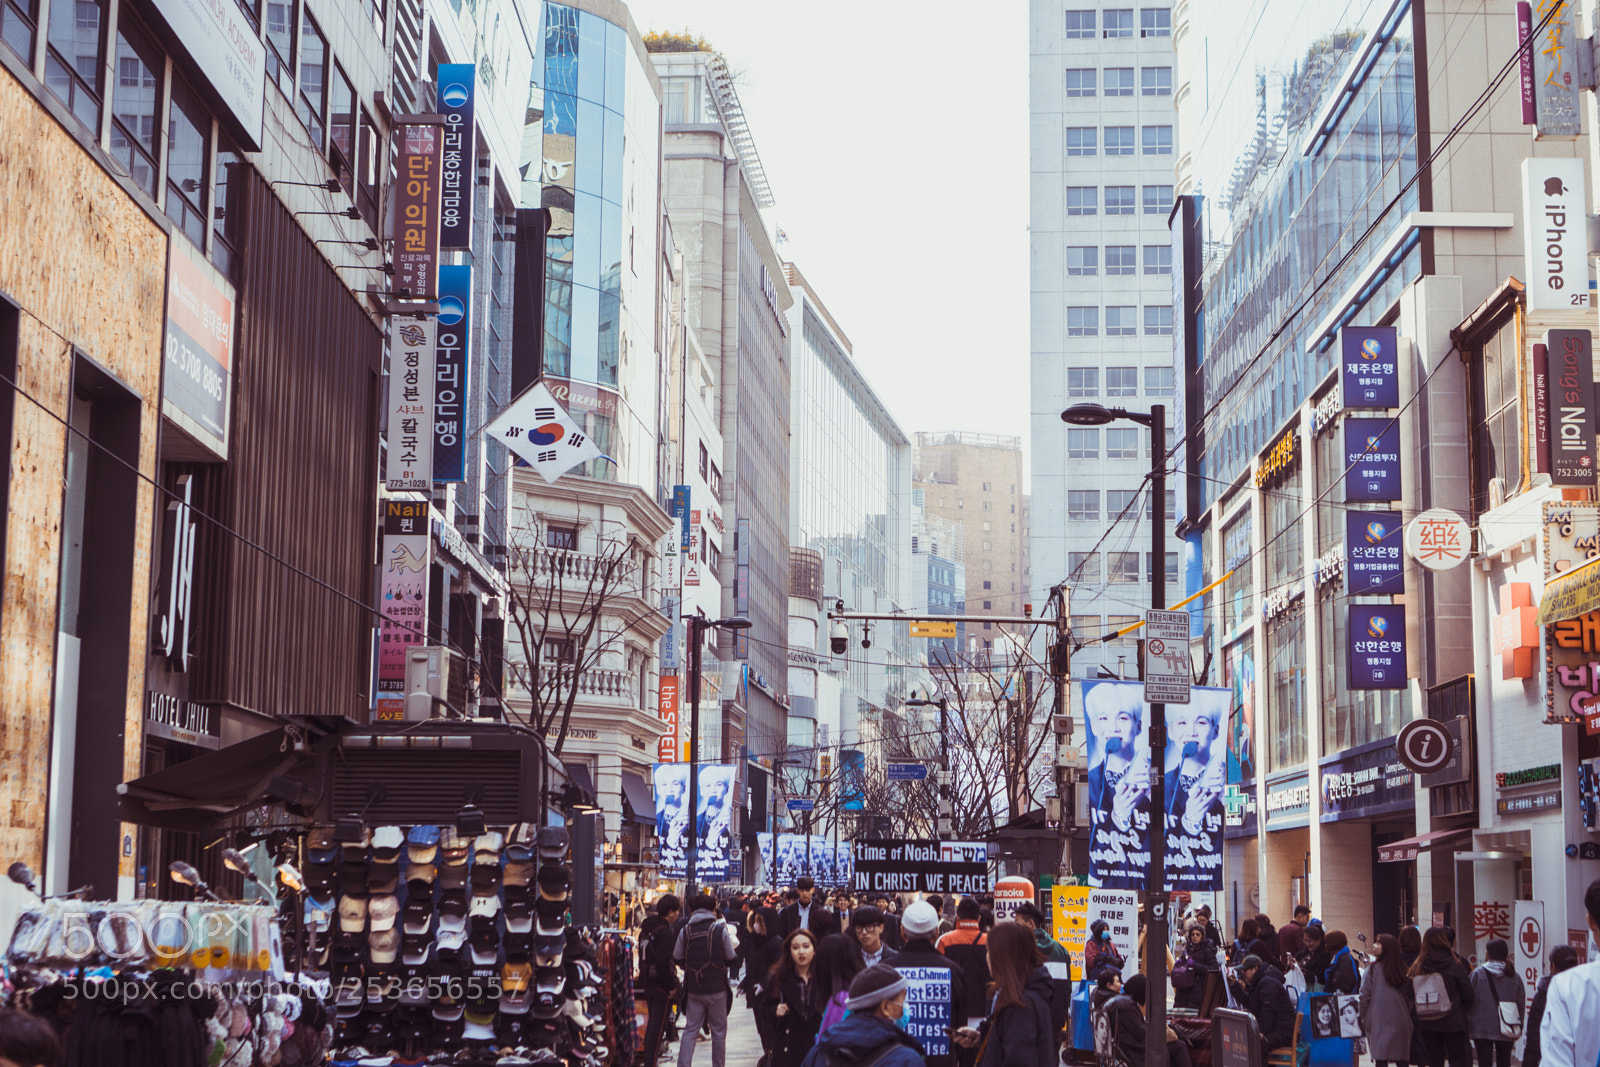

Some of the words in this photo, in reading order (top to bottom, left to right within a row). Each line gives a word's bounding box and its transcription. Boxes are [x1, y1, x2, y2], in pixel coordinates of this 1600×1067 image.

[228, 17, 257, 73] ACADEMY
[1542, 106, 1575, 117] エステ
[441, 113, 464, 228] 우리종합금융
[403, 156, 432, 252] 단아의원
[1545, 205, 1567, 290] iPhone
[417, 263, 427, 295] 성형외과
[1570, 294, 1587, 305] 2F
[202, 301, 229, 348] 임대문의
[166, 332, 178, 364] 02
[180, 343, 201, 383] 3708
[203, 364, 222, 401] 8805
[402, 351, 420, 402] 정성본
[1347, 363, 1394, 375] 제주은행
[1559, 337, 1583, 404] Song's
[435, 333, 460, 446] 우리은행
[1537, 389, 1545, 400] Art
[395, 405, 425, 414] 샤브
[1560, 407, 1587, 450] Nail
[400, 418, 419, 467] 칼국수
[1350, 454, 1397, 462] 신한금융투자
[1582, 458, 1590, 466] 3F
[1557, 468, 1592, 477] 752.3005
[390, 480, 426, 488] 773-1028
[388, 503, 427, 516] Nail
[400, 519, 414, 532] 퀸
[1418, 519, 1461, 560] 藥
[687, 535, 699, 577] 쥬비스
[1352, 547, 1399, 559] 신한은행
[386, 606, 420, 616] 속눈썹연장
[1354, 641, 1402, 653] 신한은행
[380, 681, 388, 689] 7F
[662, 686, 675, 709] the
[150, 691, 180, 727] HOTEL
[184, 702, 209, 735] JHILL
[1505, 770, 1522, 786] GOOD
[1523, 764, 1559, 784] PHARMACY
[856, 842, 886, 861] time
[891, 847, 902, 860] of
[904, 844, 940, 862] Noah,
[855, 872, 869, 890] IN
[875, 873, 918, 890] CHRIST
[926, 874, 943, 891] WE
[949, 875, 985, 893] PEACE
[1093, 895, 1134, 905] 아이폰수리
[1113, 926, 1129, 935] 판매
[1473, 902, 1511, 940] 藥
[925, 984, 950, 1001] 333
